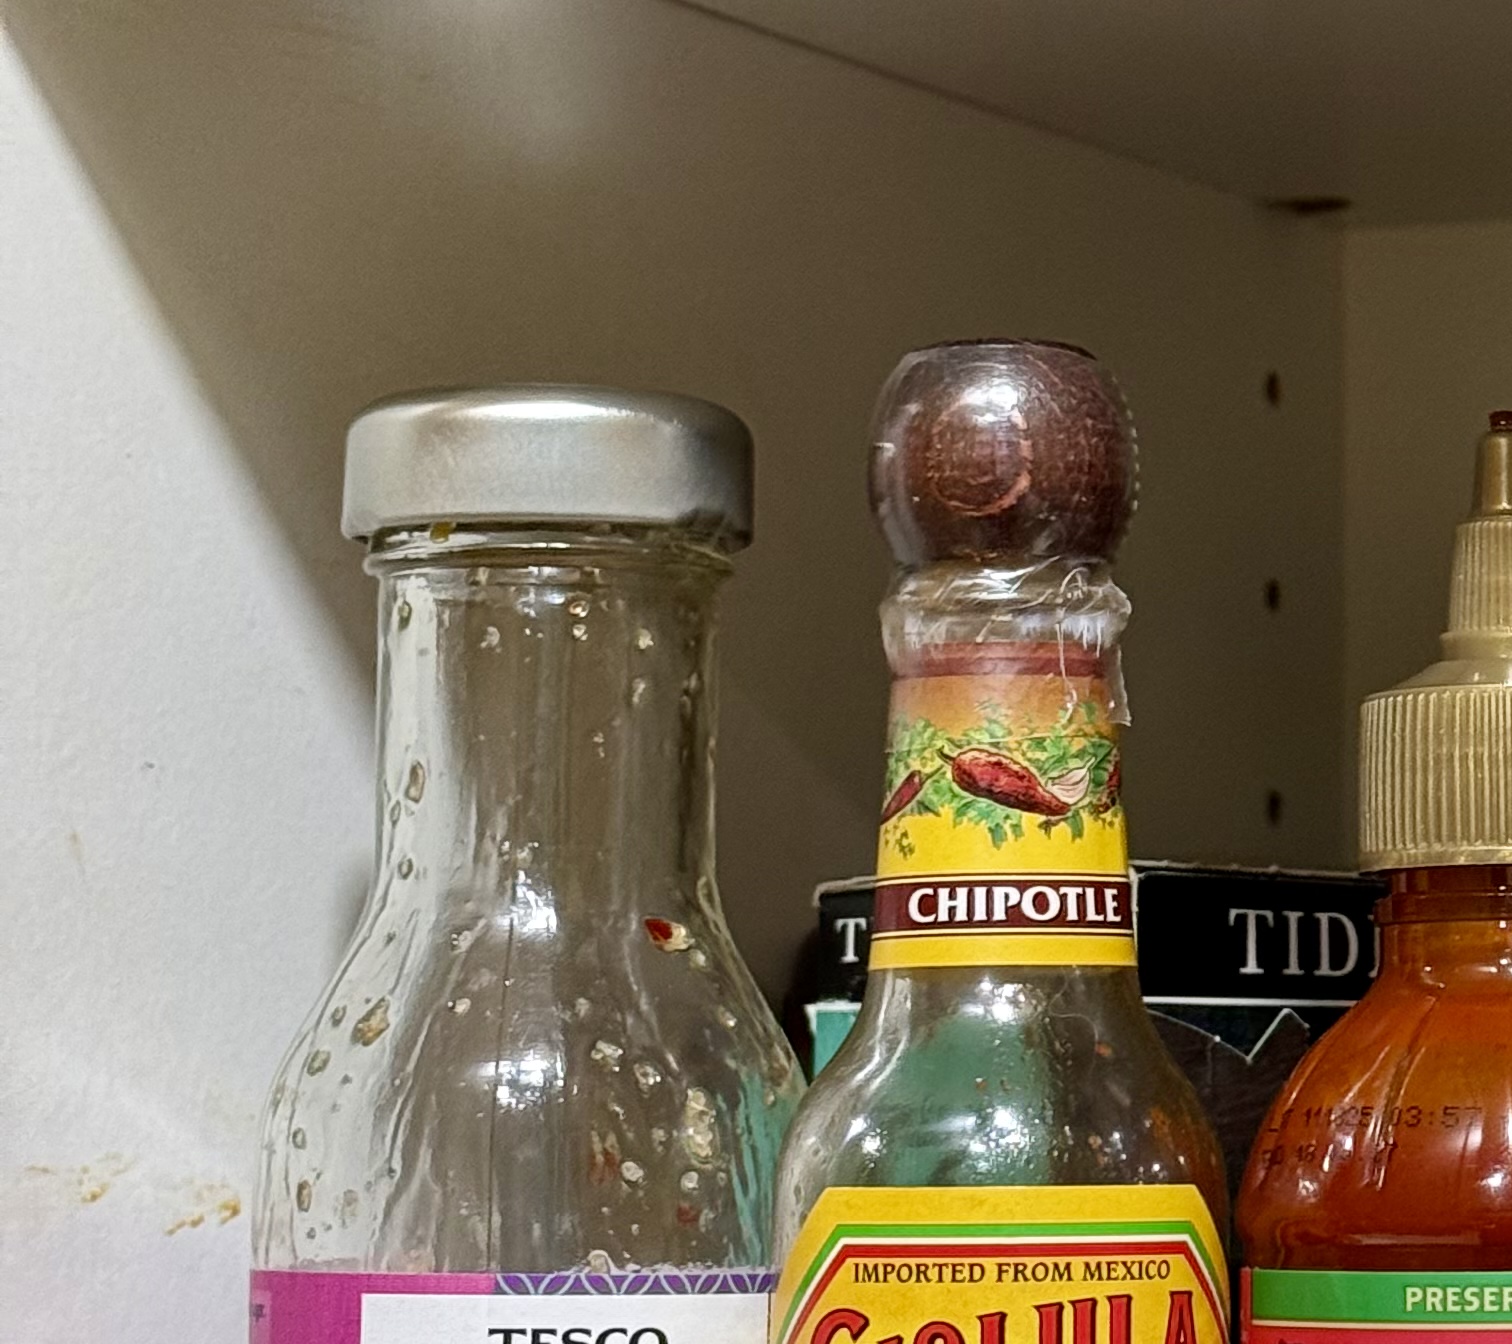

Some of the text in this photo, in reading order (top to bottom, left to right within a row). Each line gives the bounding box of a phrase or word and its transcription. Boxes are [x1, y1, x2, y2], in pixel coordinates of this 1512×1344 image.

[907, 885, 1122, 923] CHIPOTLE
[853, 1259, 1171, 1283] IMPORTED FROM MEXICO
